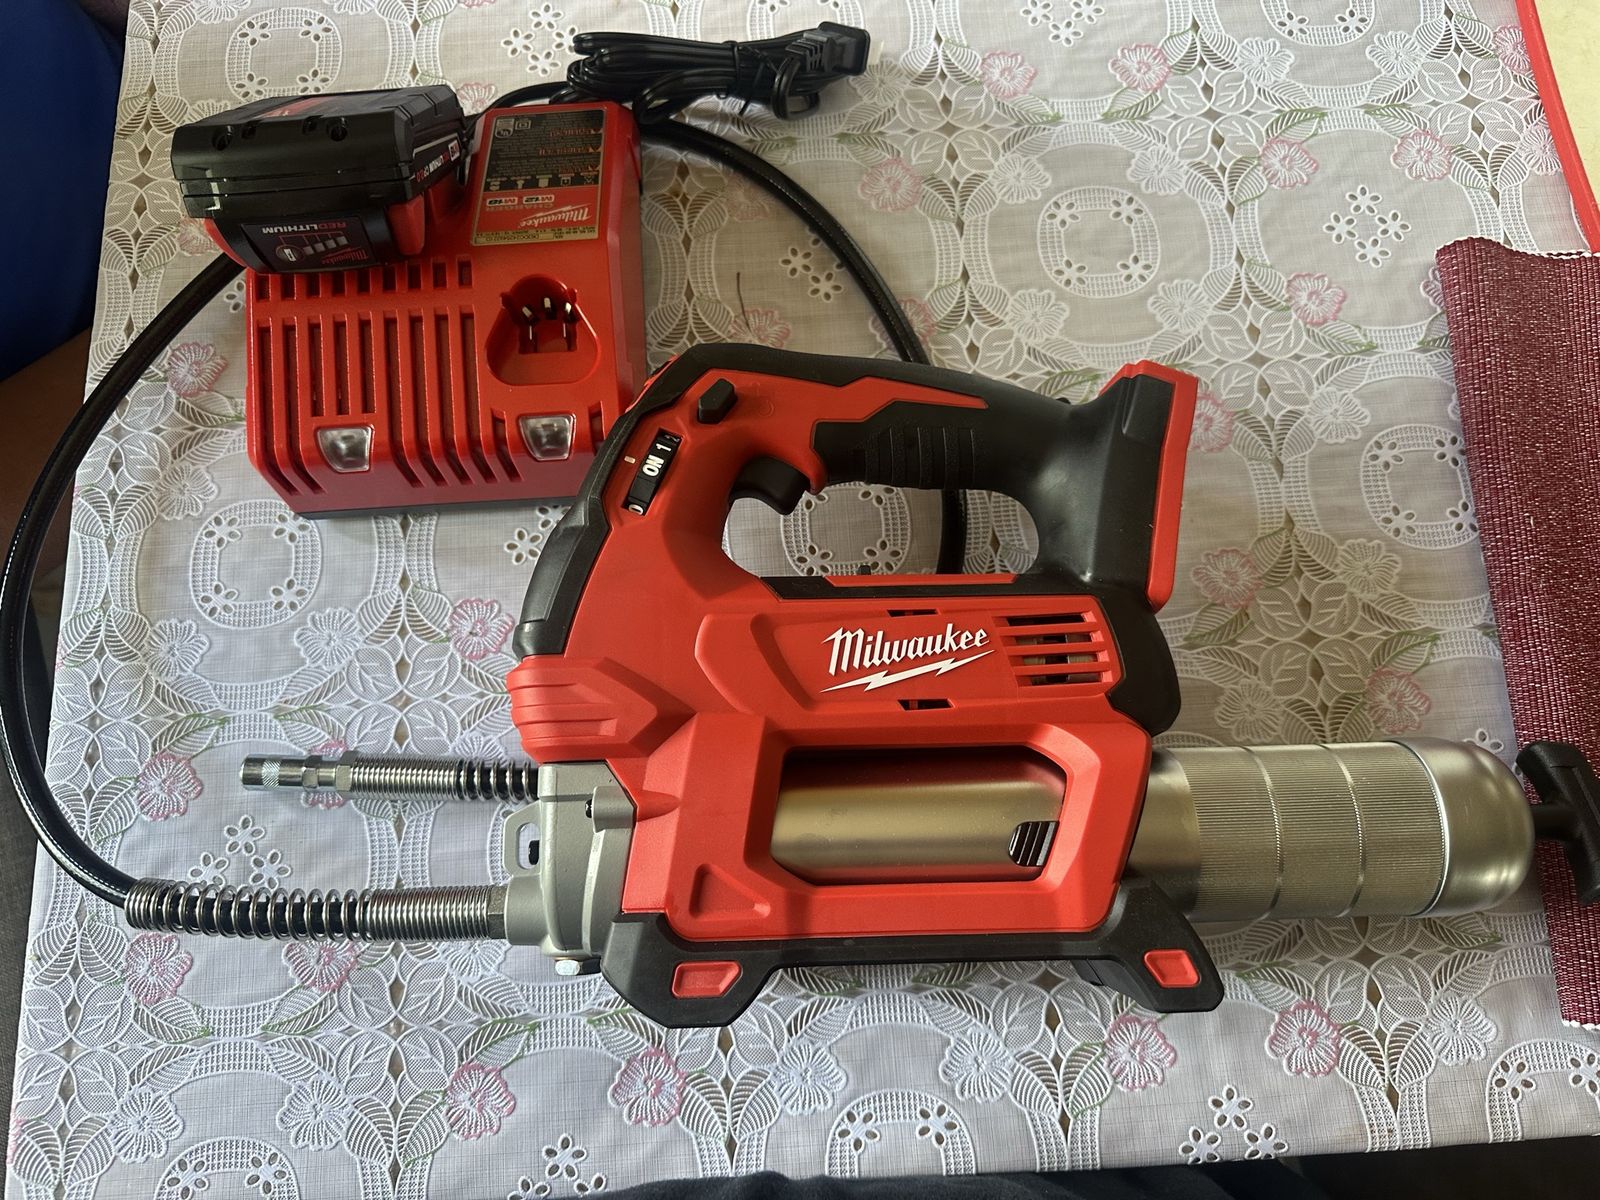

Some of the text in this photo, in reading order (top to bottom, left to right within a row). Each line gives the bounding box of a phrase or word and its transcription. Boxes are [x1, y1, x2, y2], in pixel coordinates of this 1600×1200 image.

[261, 221, 347, 234] REDLITHIUM
[519, 207, 592, 228] Milwaukee
[642, 454, 665, 477] ON
[655, 443, 672, 452] 1
[820, 623, 991, 677] Milwaukee
